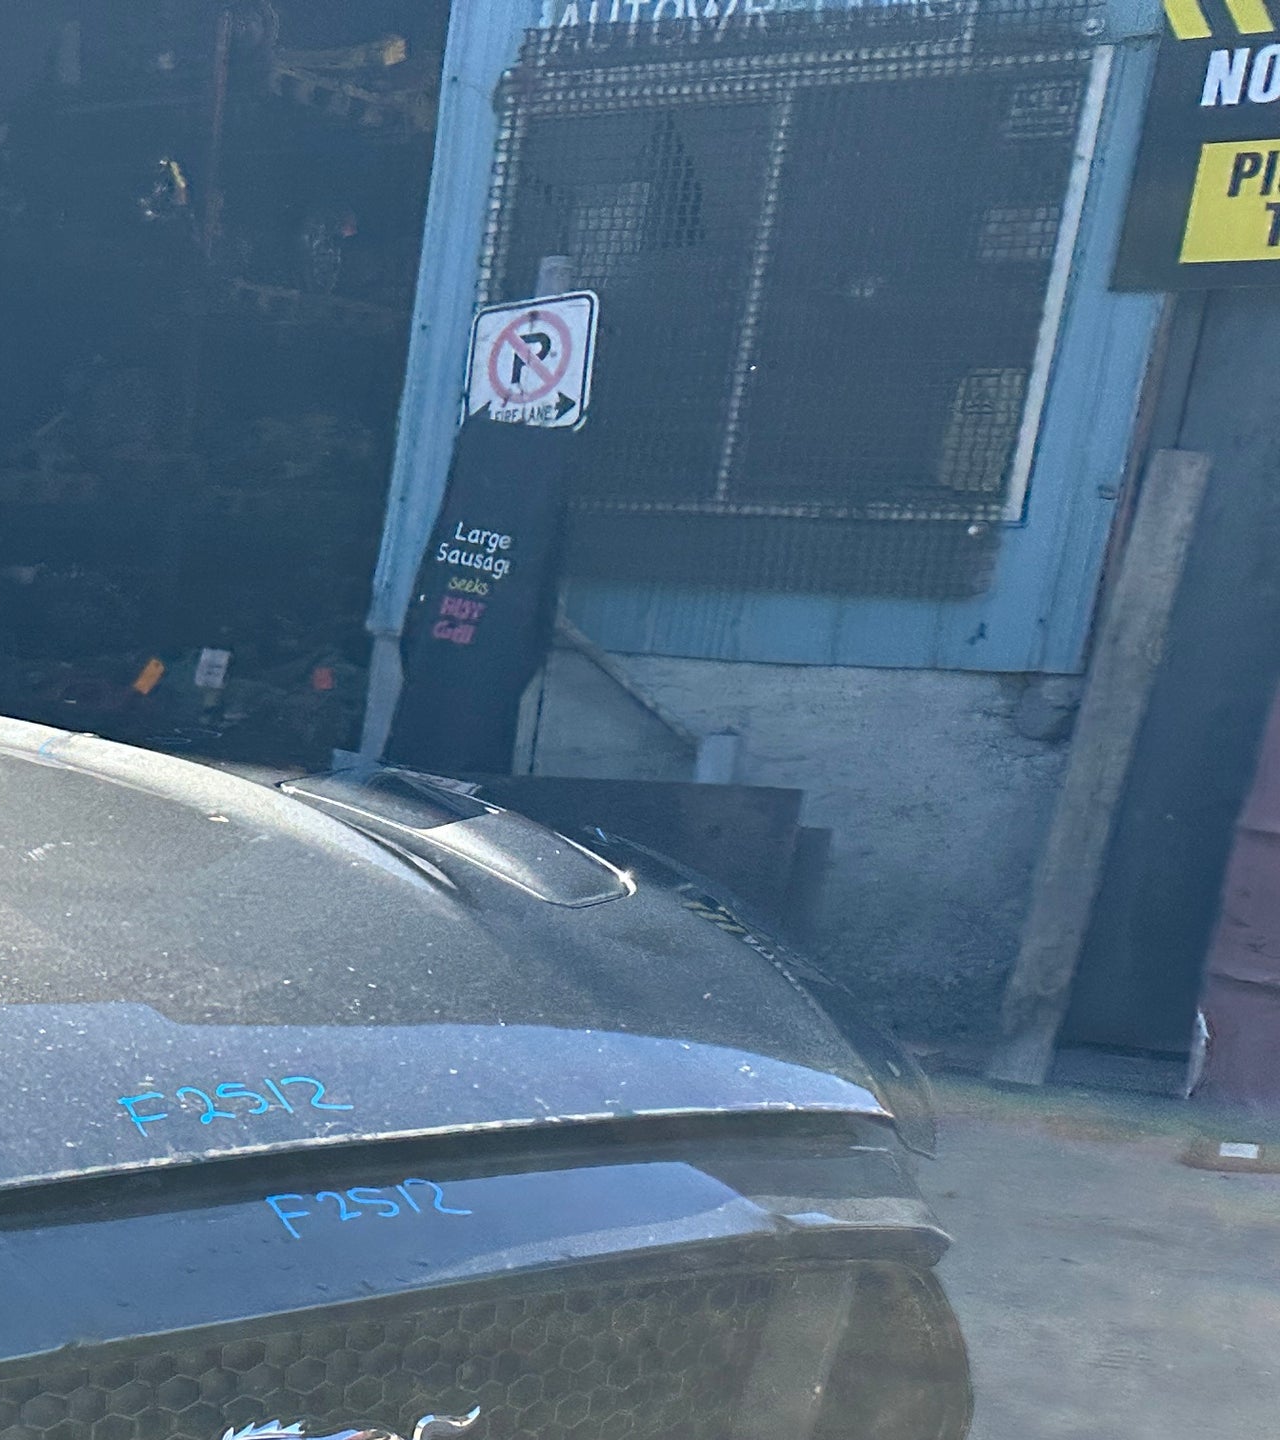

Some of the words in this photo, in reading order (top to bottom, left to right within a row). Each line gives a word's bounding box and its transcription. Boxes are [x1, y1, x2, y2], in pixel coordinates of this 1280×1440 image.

[1227, 150, 1280, 198] PI
[455, 521, 512, 553] Large
[448, 577, 489, 596] seeks
[117, 1075, 354, 1138] F2512
[265, 1177, 473, 1240] F2512
